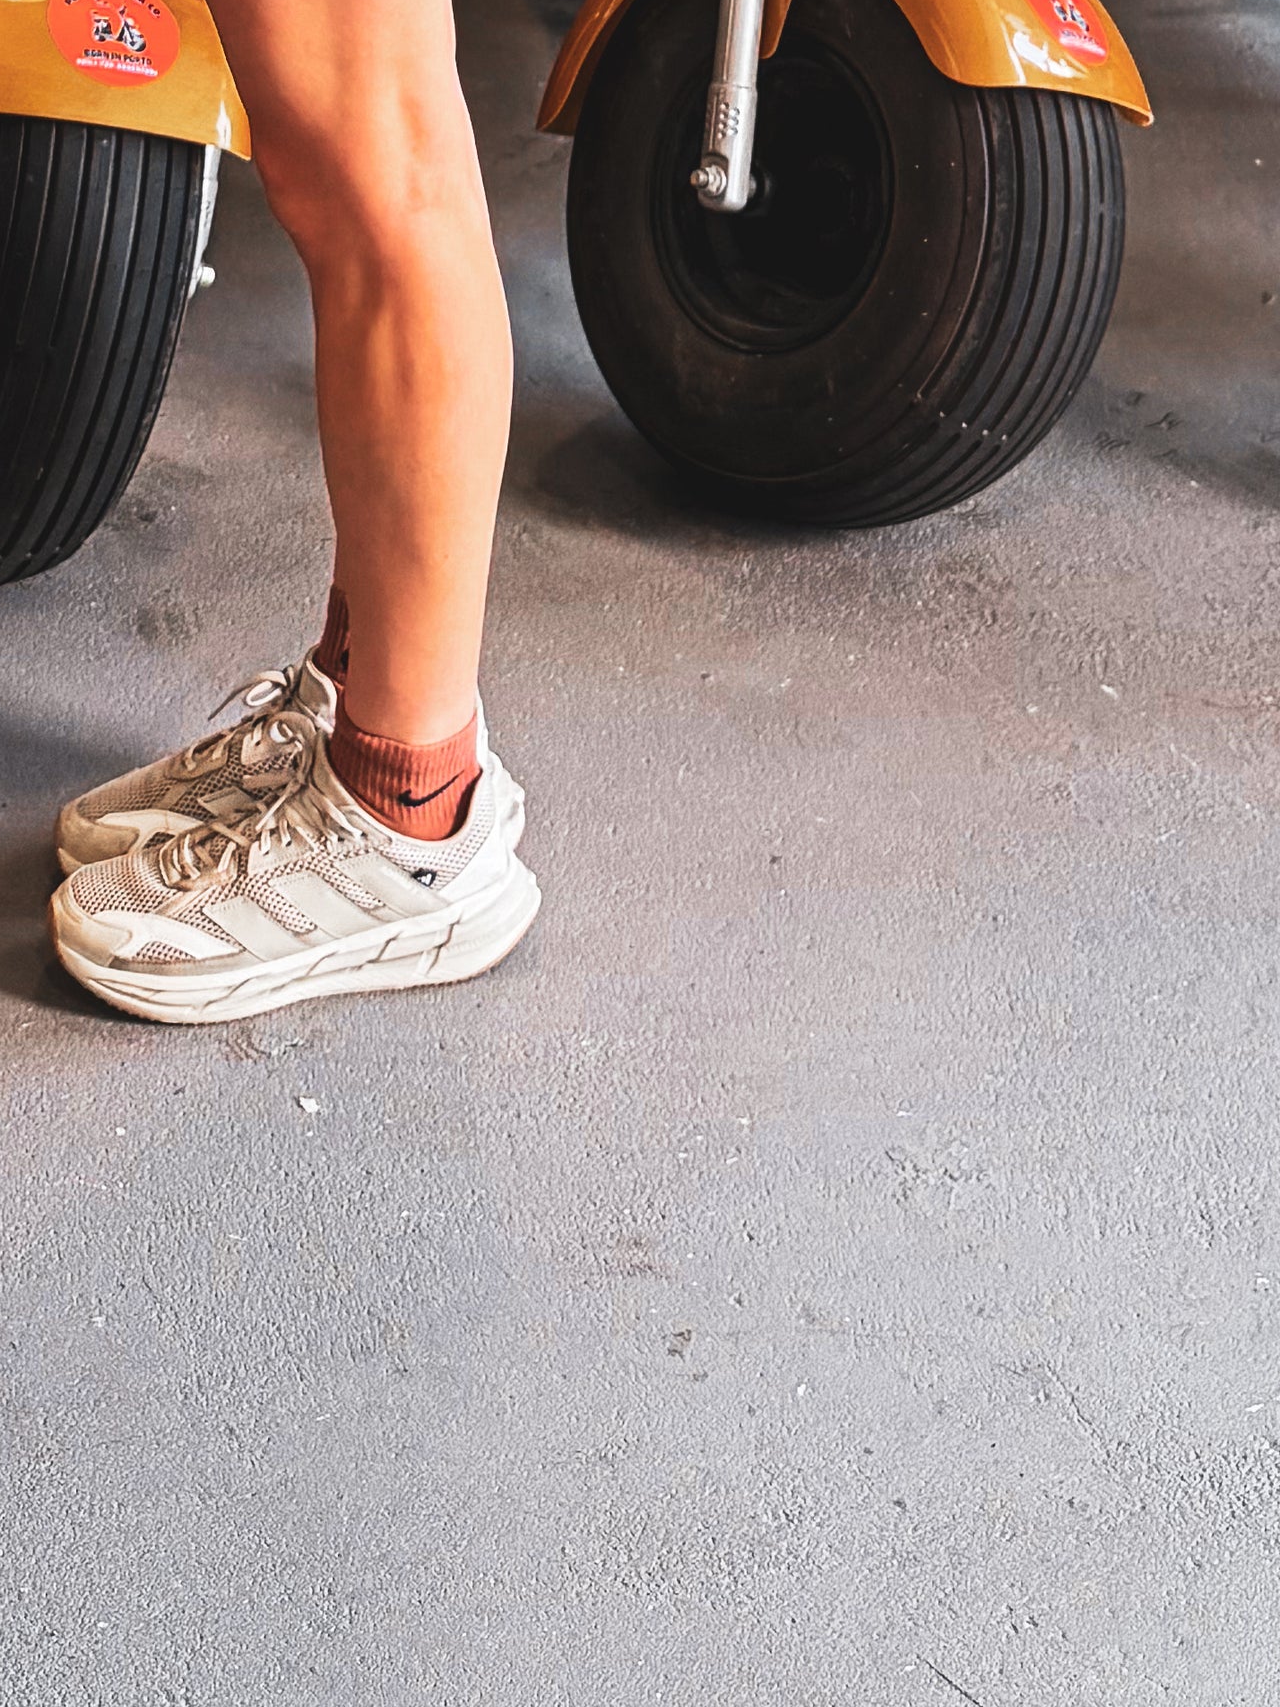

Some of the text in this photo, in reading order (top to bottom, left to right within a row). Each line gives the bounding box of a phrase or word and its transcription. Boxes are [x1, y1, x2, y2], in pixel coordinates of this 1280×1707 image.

[83, 48, 152, 66] BORN IN PORTO
